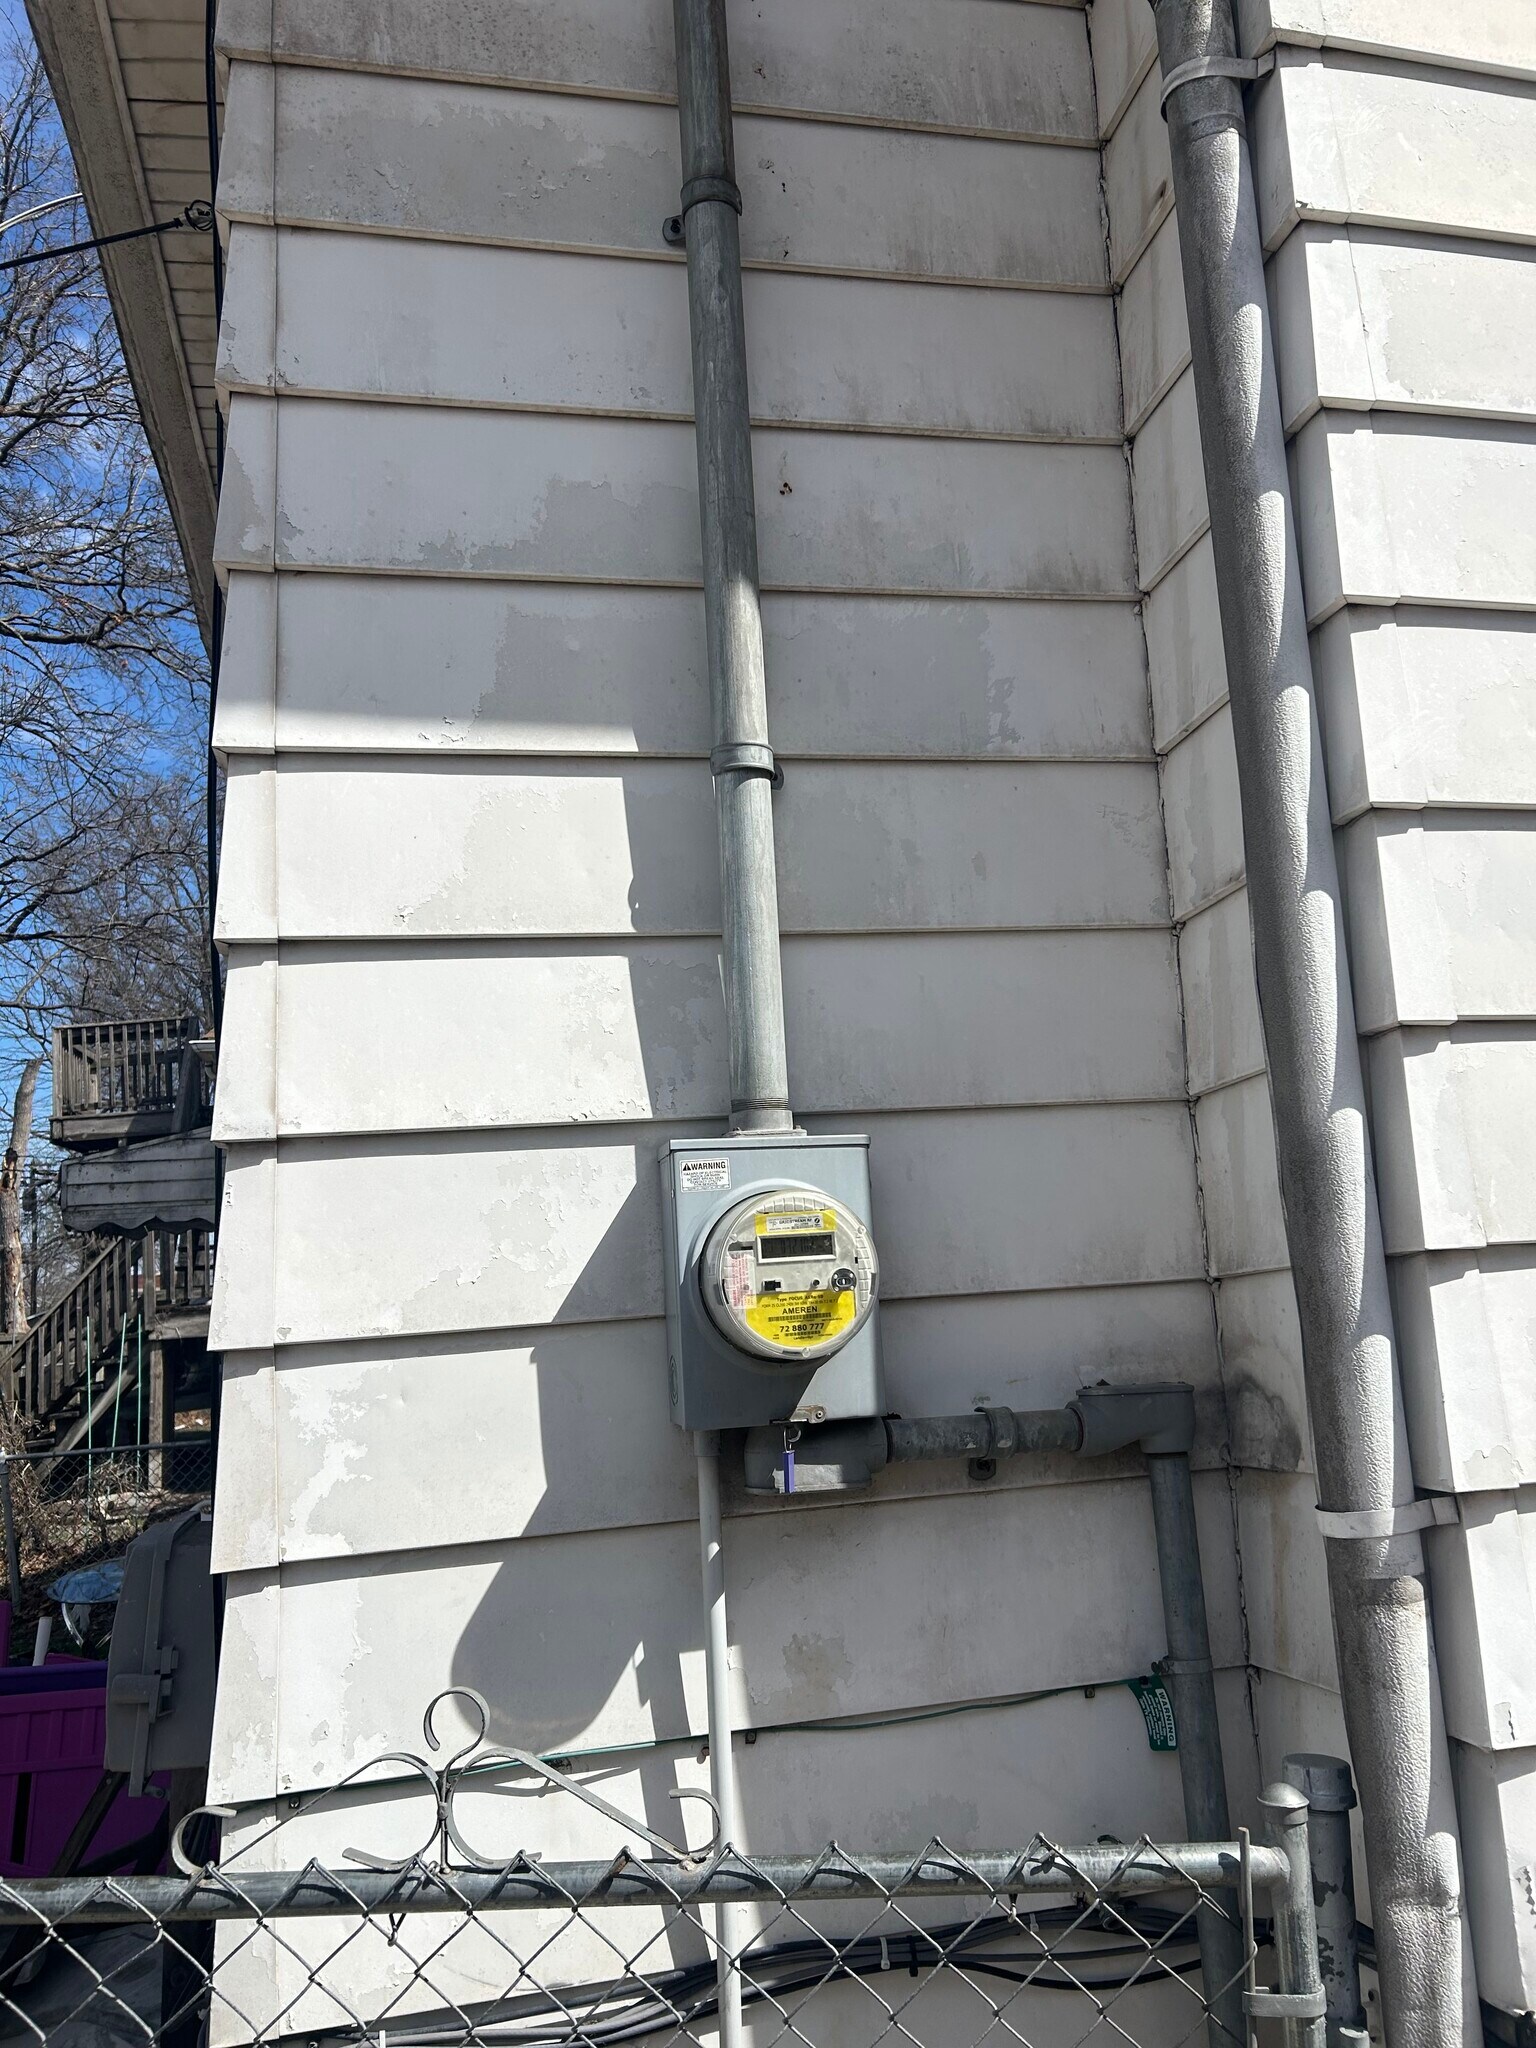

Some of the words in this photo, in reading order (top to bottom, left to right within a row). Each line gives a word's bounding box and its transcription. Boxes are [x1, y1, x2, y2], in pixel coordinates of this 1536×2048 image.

[691, 1161, 726, 1170] WARNING
[782, 1306, 818, 1315] AMEREN
[780, 1325, 790, 1333] 72
[792, 1324, 807, 1332] 880
[809, 1322, 825, 1330] 777
[1159, 1691, 1175, 1742] WARNING
